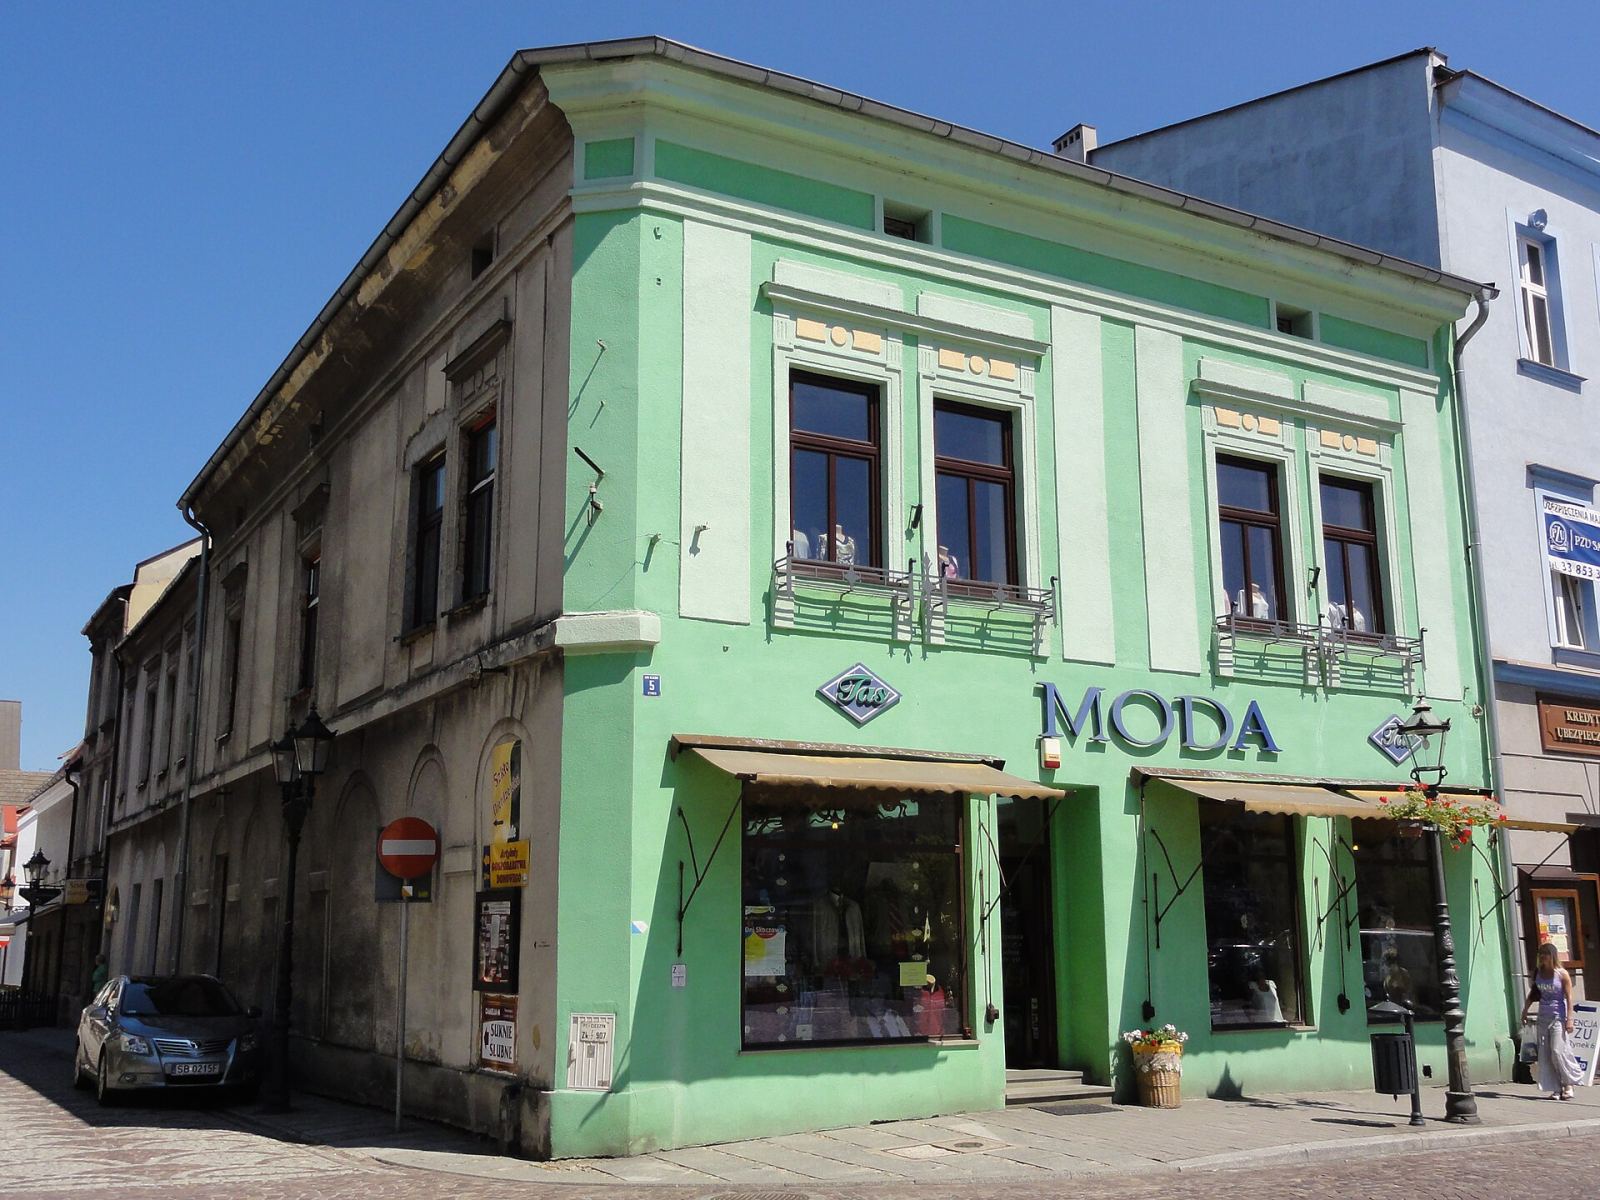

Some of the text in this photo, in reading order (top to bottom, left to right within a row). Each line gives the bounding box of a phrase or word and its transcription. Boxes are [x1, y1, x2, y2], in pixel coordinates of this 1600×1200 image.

[1574, 535, 1591, 549] PZU
[1561, 561, 1572, 574] 33
[1575, 564, 1593, 578] 853
[649, 680, 655, 691] 5
[1036, 681, 1283, 753] MODA
[1573, 1018, 1598, 1028] ENCJA
[490, 1023, 513, 1039] SUKNIE
[1574, 1027, 1593, 1040] ZU
